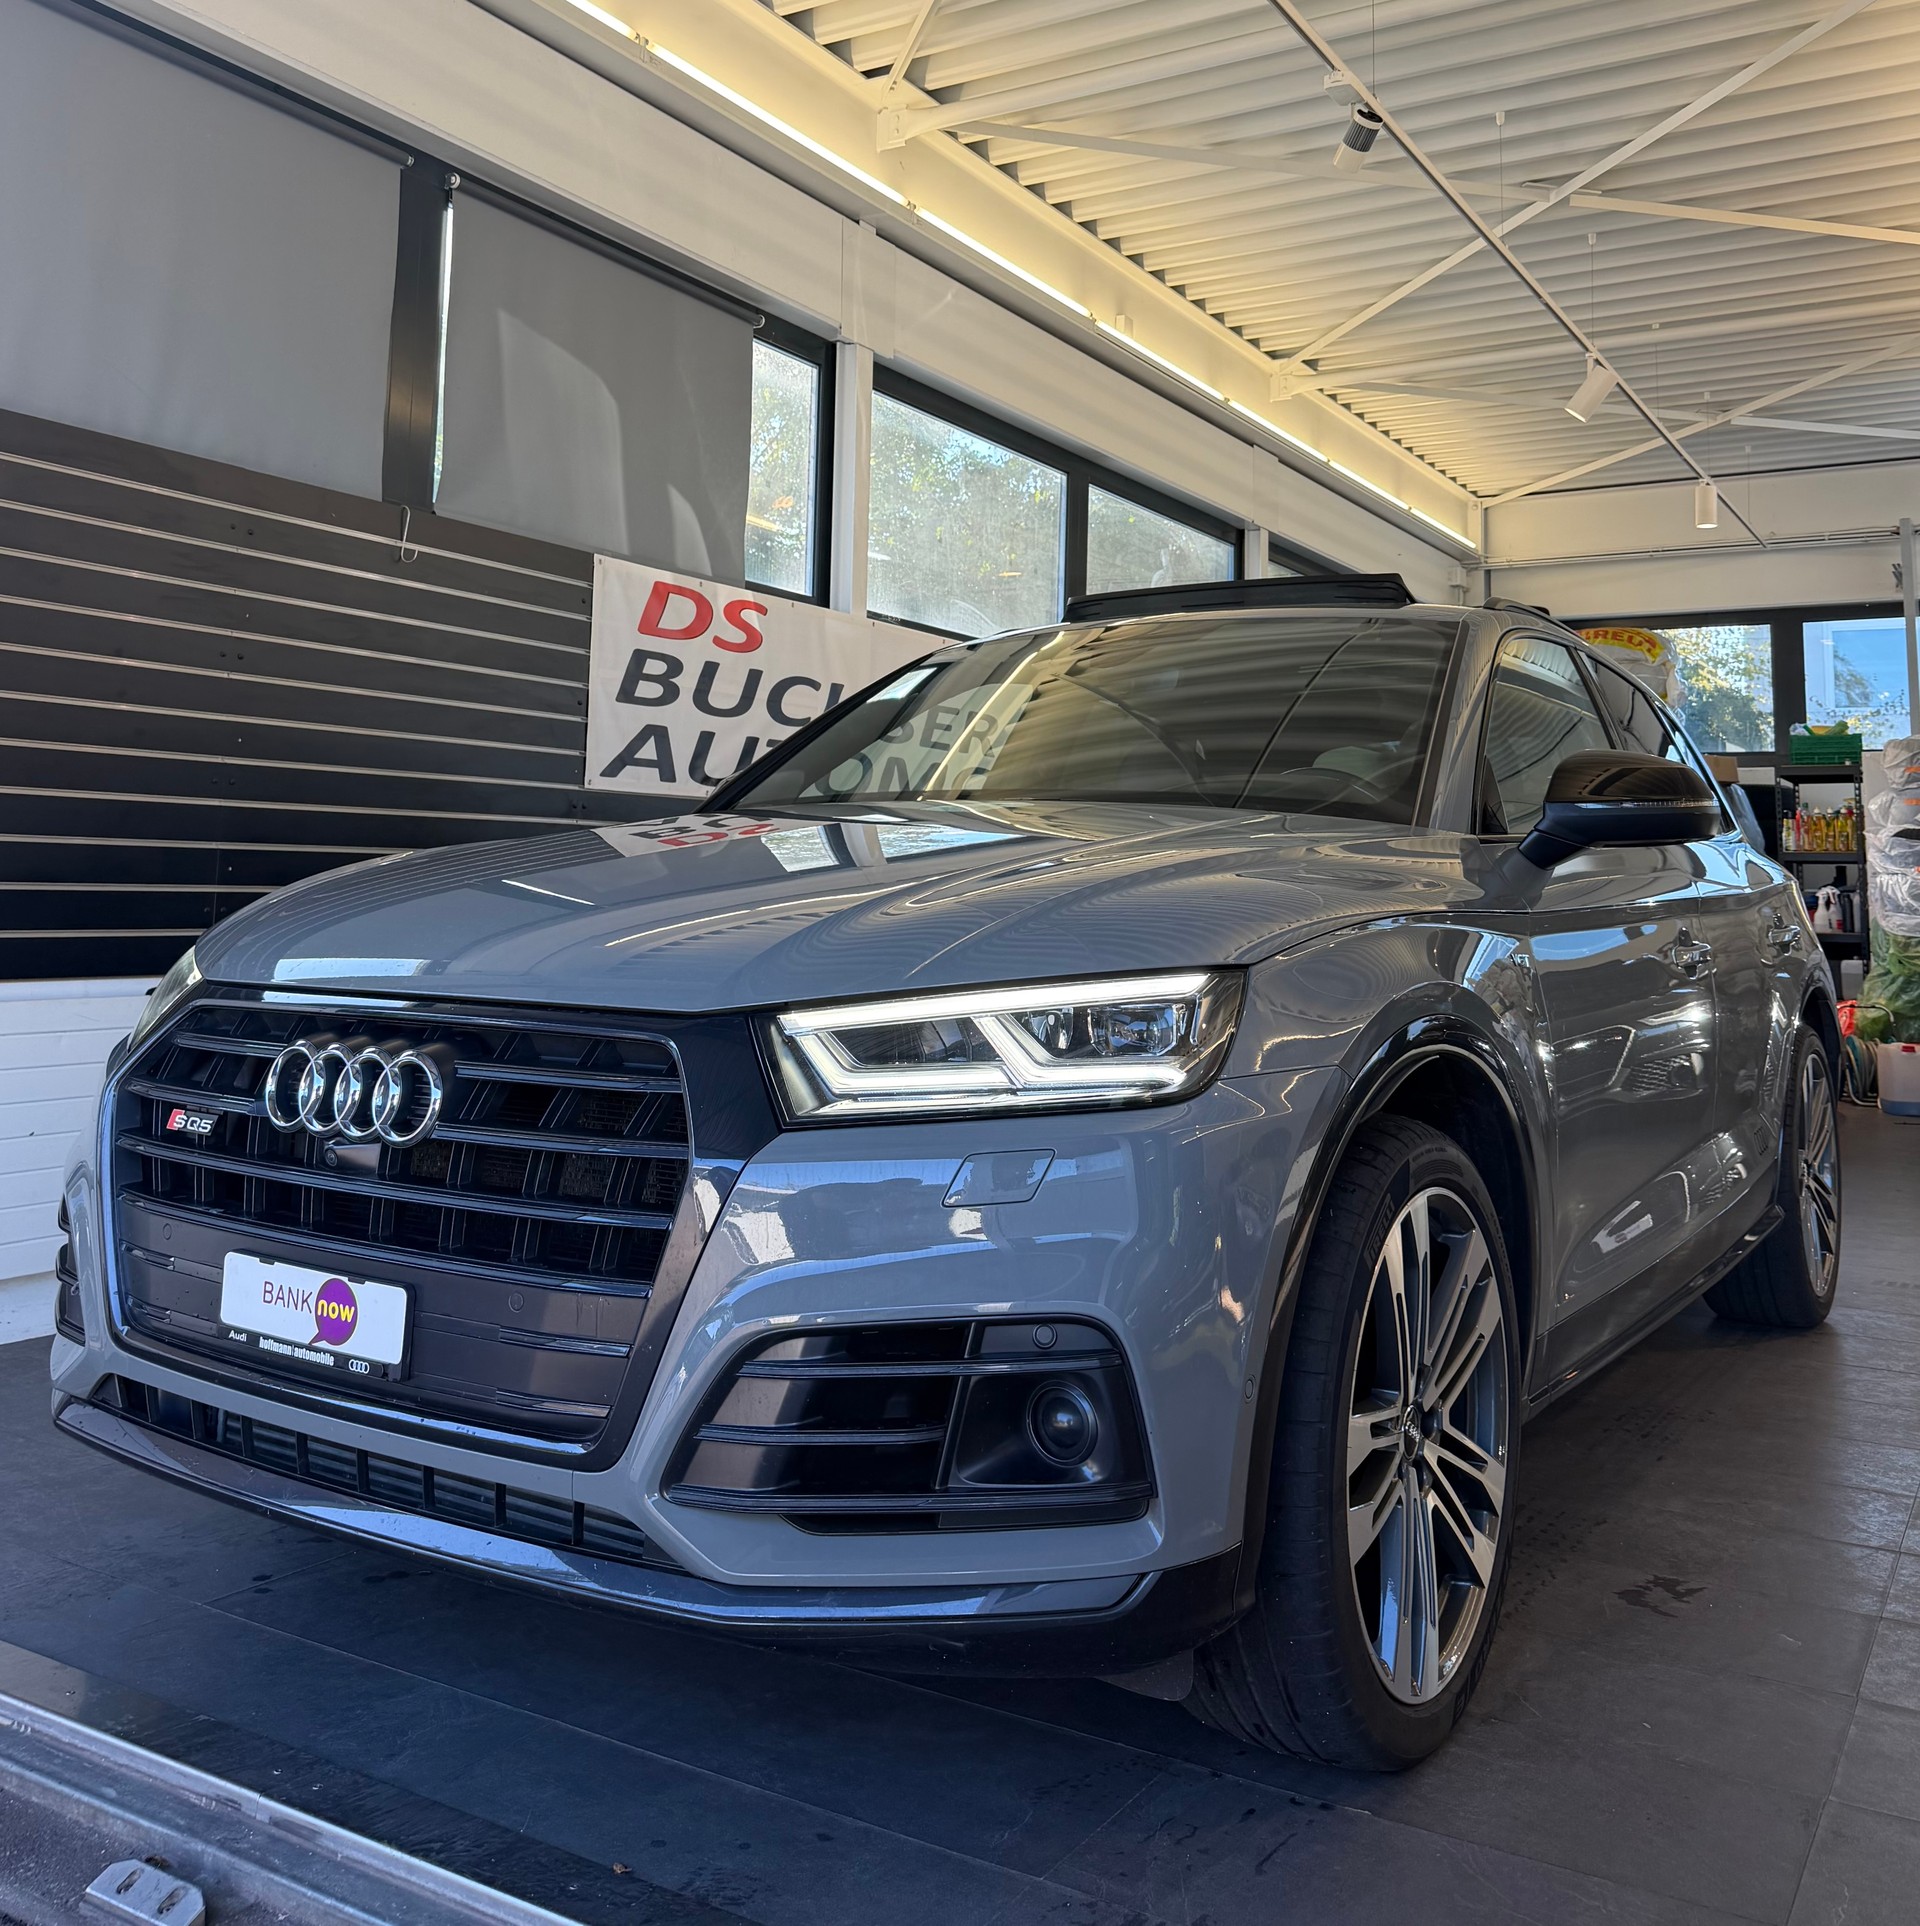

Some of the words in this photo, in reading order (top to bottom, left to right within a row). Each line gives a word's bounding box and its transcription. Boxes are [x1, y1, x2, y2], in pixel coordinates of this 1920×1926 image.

[637, 580, 767, 653] DS
[173, 1112, 213, 1133] SQ5
[262, 1280, 313, 1315] BANK
[317, 1299, 355, 1323] now
[228, 1329, 248, 1343] Audi
